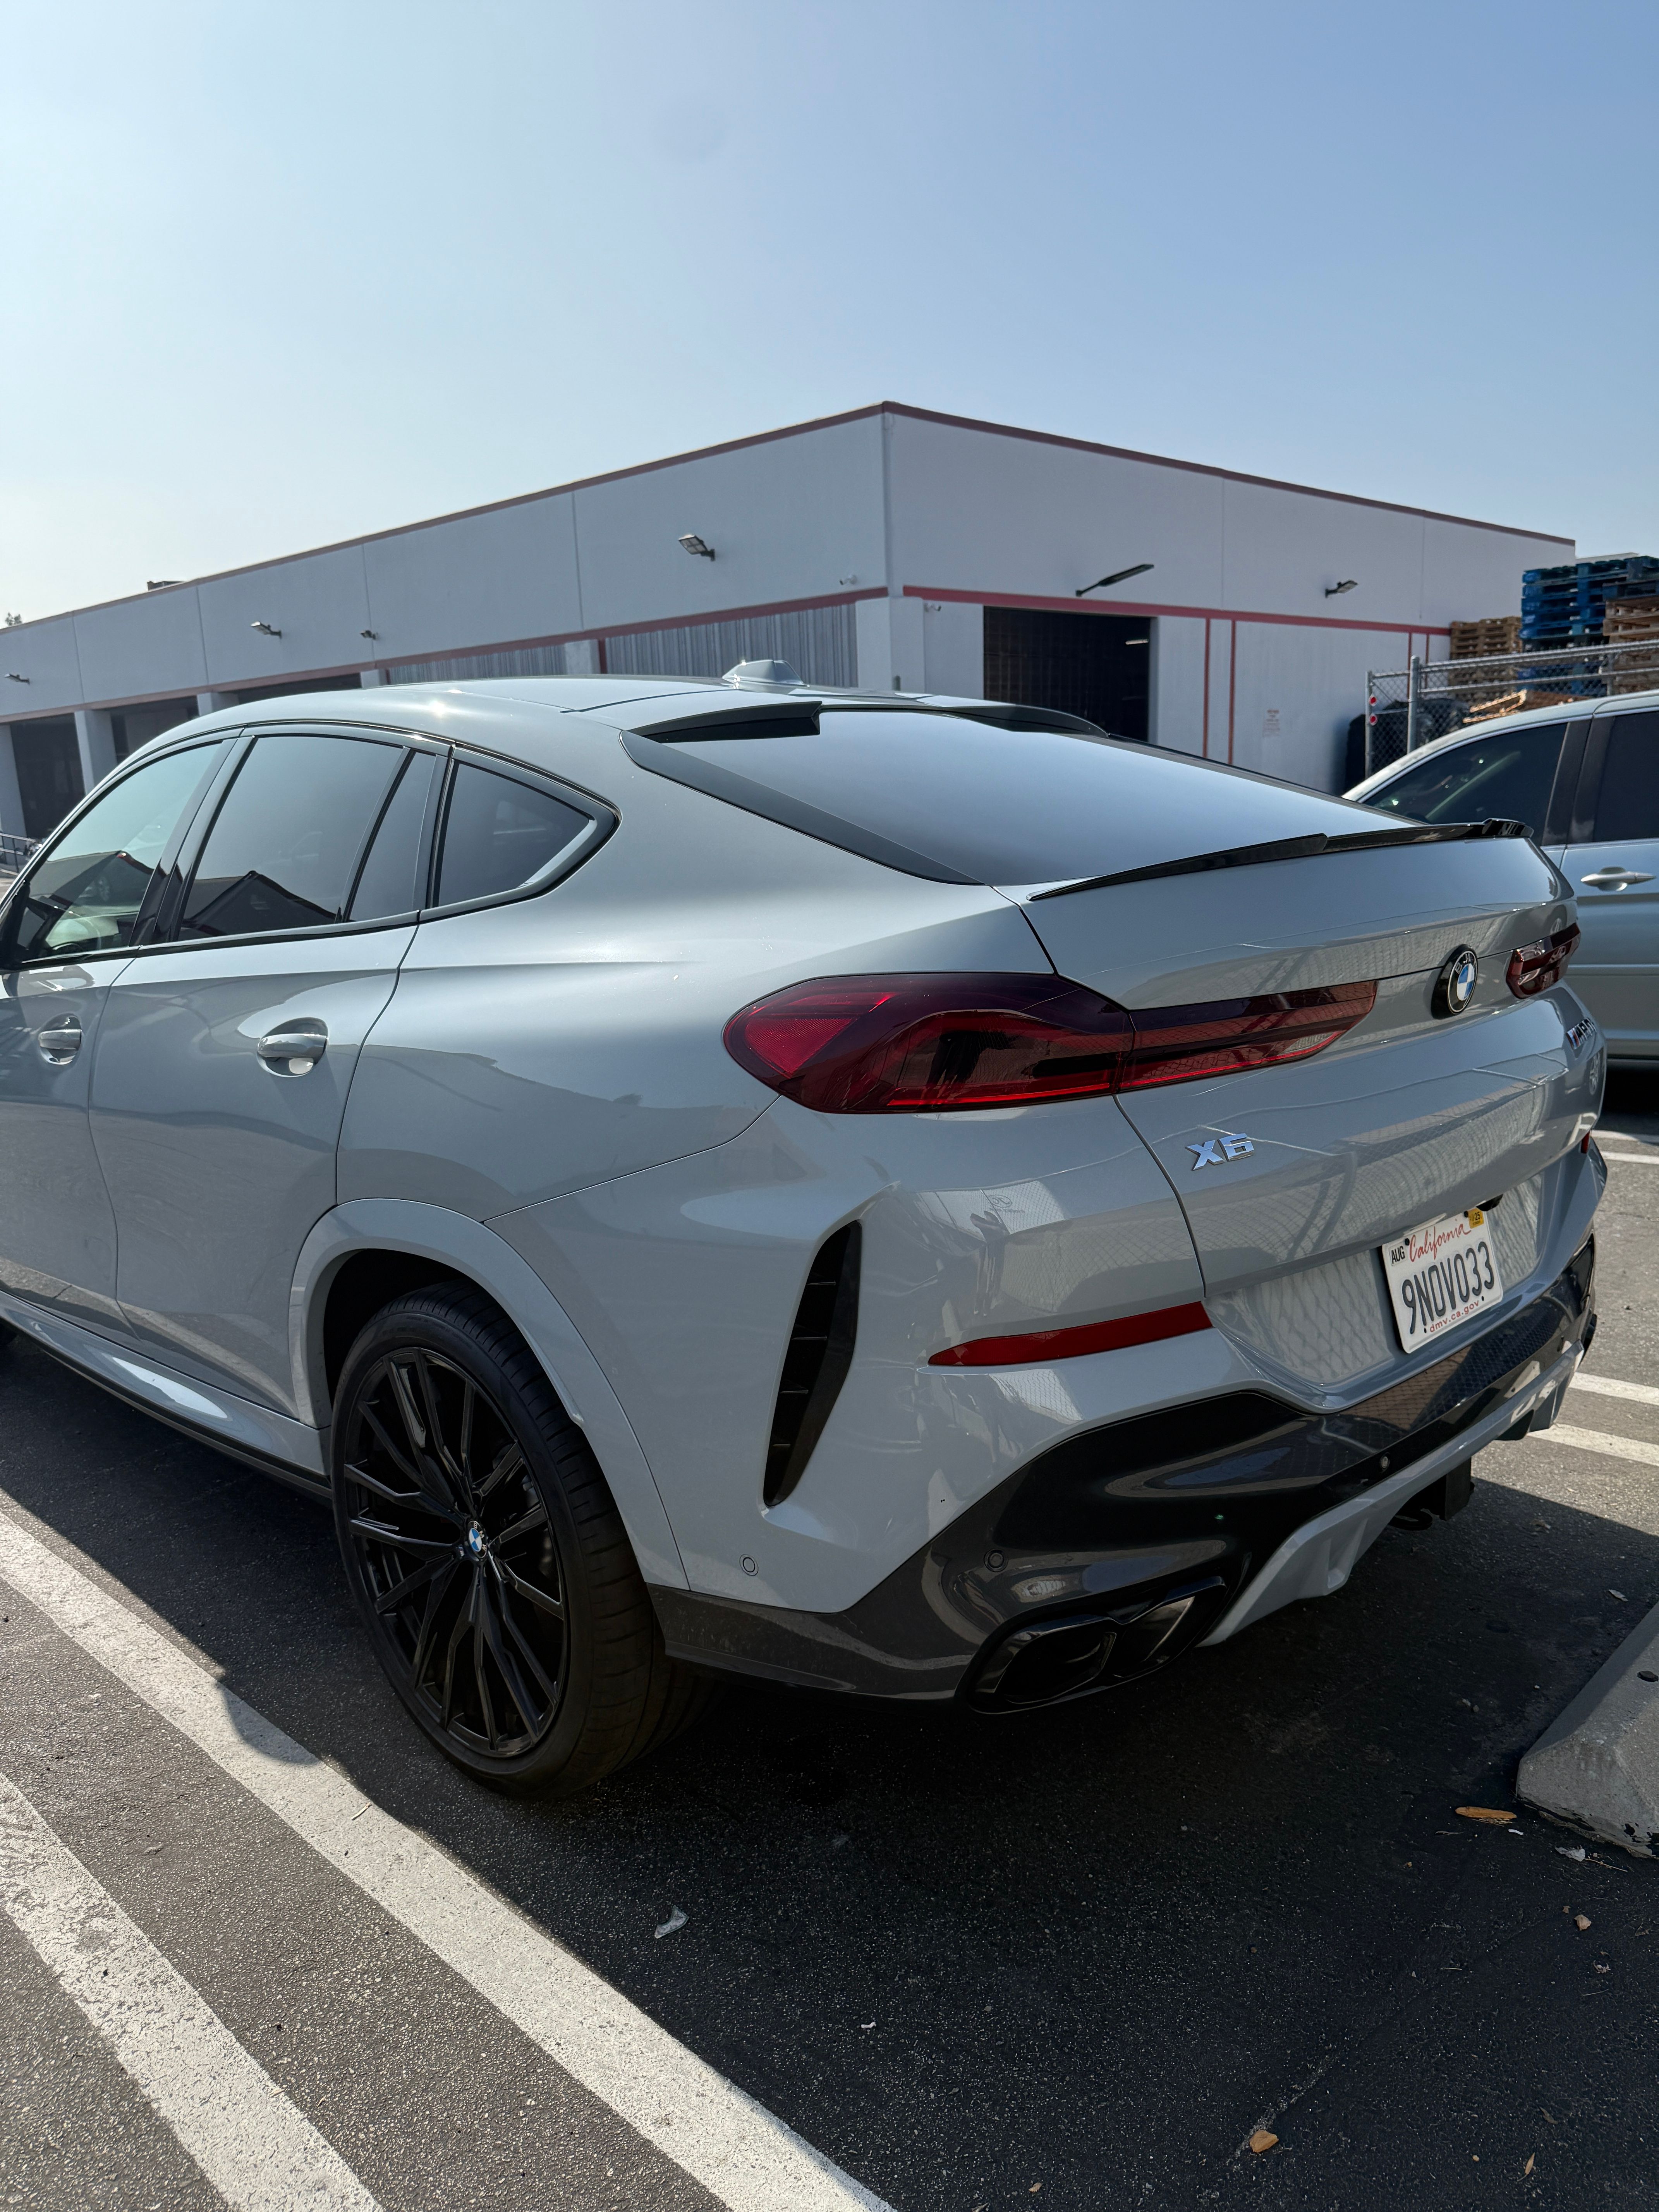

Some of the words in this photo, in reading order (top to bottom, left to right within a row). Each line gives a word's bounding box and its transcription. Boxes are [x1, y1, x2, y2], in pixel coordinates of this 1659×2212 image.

[1185, 1133, 1254, 1171] X6
[1474, 1211, 1480, 1221] 25
[1391, 1246, 1405, 1264] AUG
[1409, 1223, 1471, 1262] California
[1402, 1242, 1494, 1334] 9NOV033
[1429, 1300, 1479, 1333] dmv.ca.gov
[474, 1522, 487, 1551] BMW
